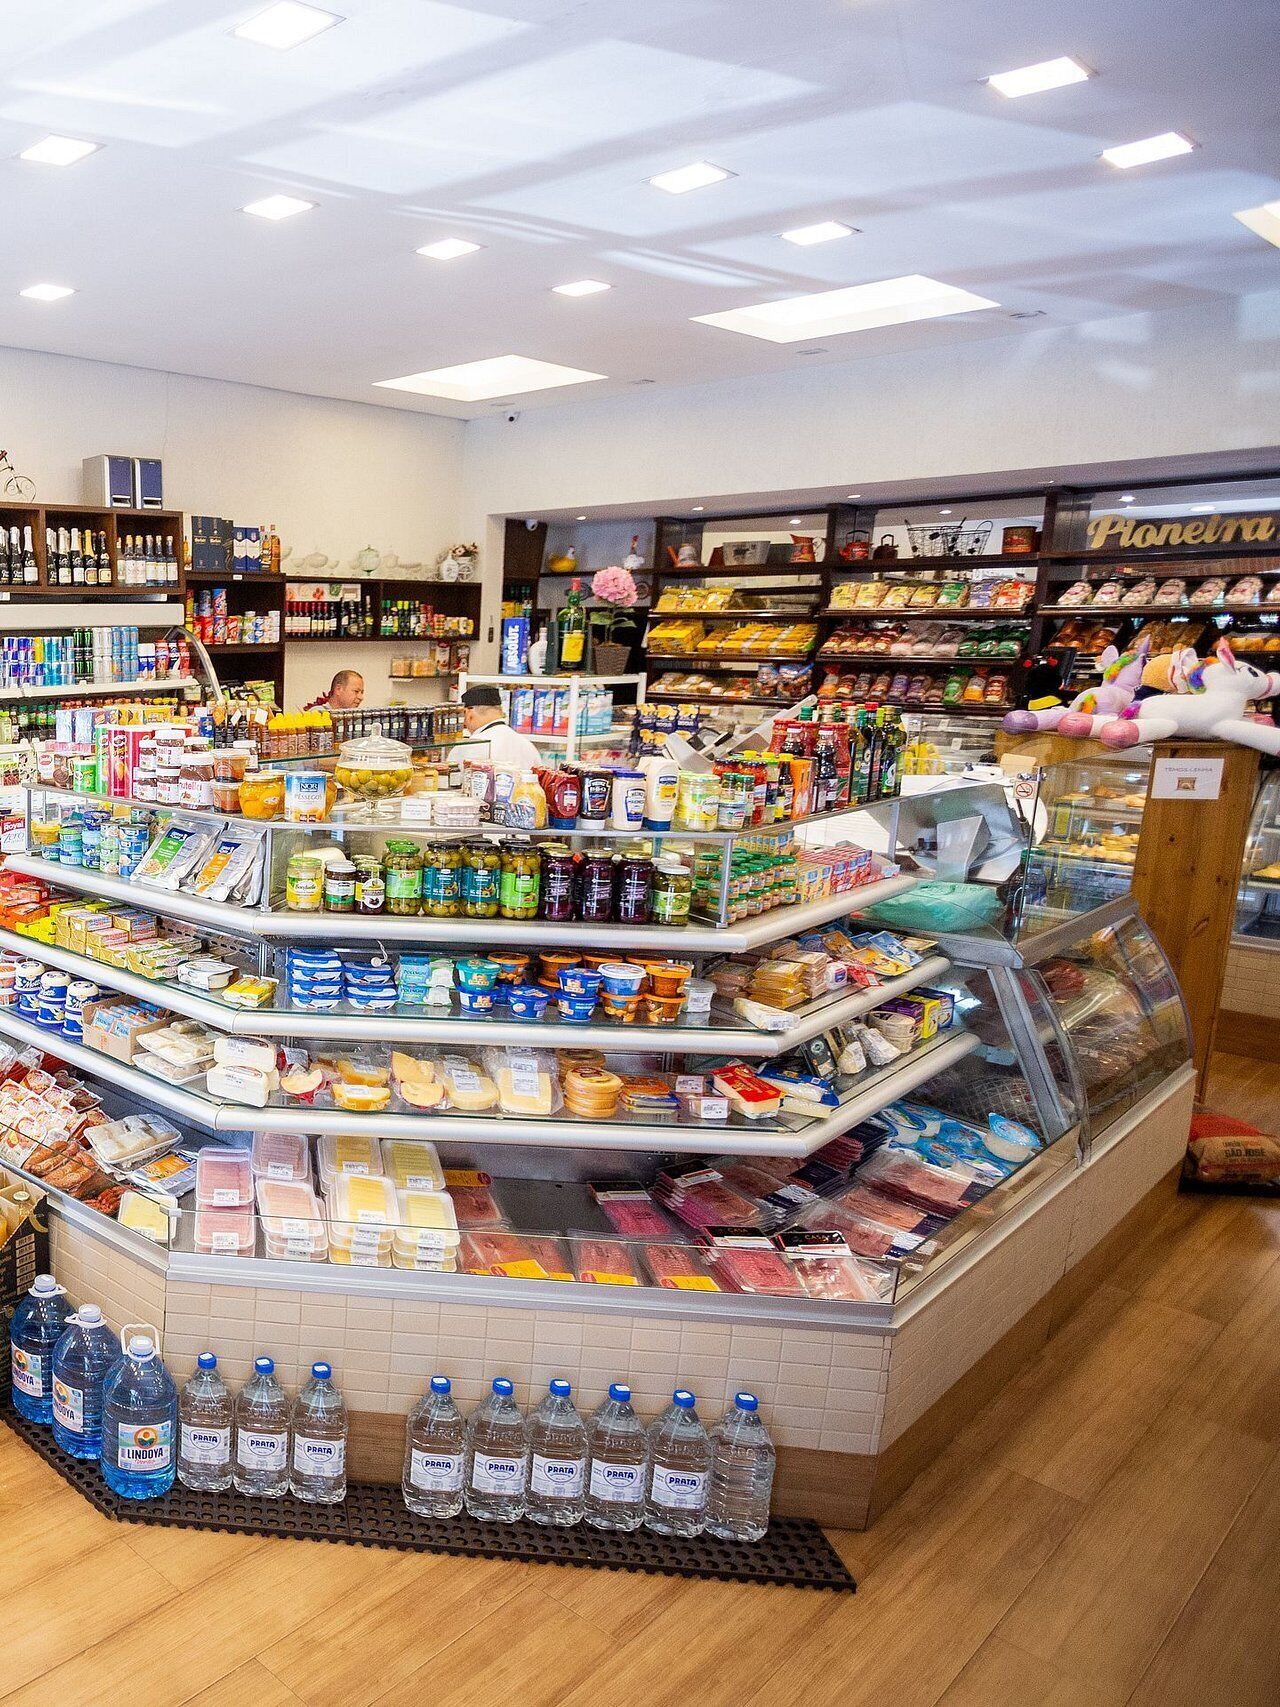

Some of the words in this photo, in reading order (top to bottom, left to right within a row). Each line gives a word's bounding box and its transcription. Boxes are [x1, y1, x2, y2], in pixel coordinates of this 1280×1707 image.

[1087, 514, 1275, 549] Pioneira
[3, 822, 25, 832] Royal
[193, 1434, 218, 1445] PRATA
[250, 1439, 276, 1449] PRATA
[126, 1447, 164, 1460] LINDOYA
[307, 1445, 333, 1455] PRATA
[425, 1460, 452, 1470] PRATA
[488, 1463, 515, 1473] PRATA
[548, 1465, 574, 1476] PRATA
[607, 1470, 634, 1480] PRATA
[669, 1477, 696, 1488] PRATA
